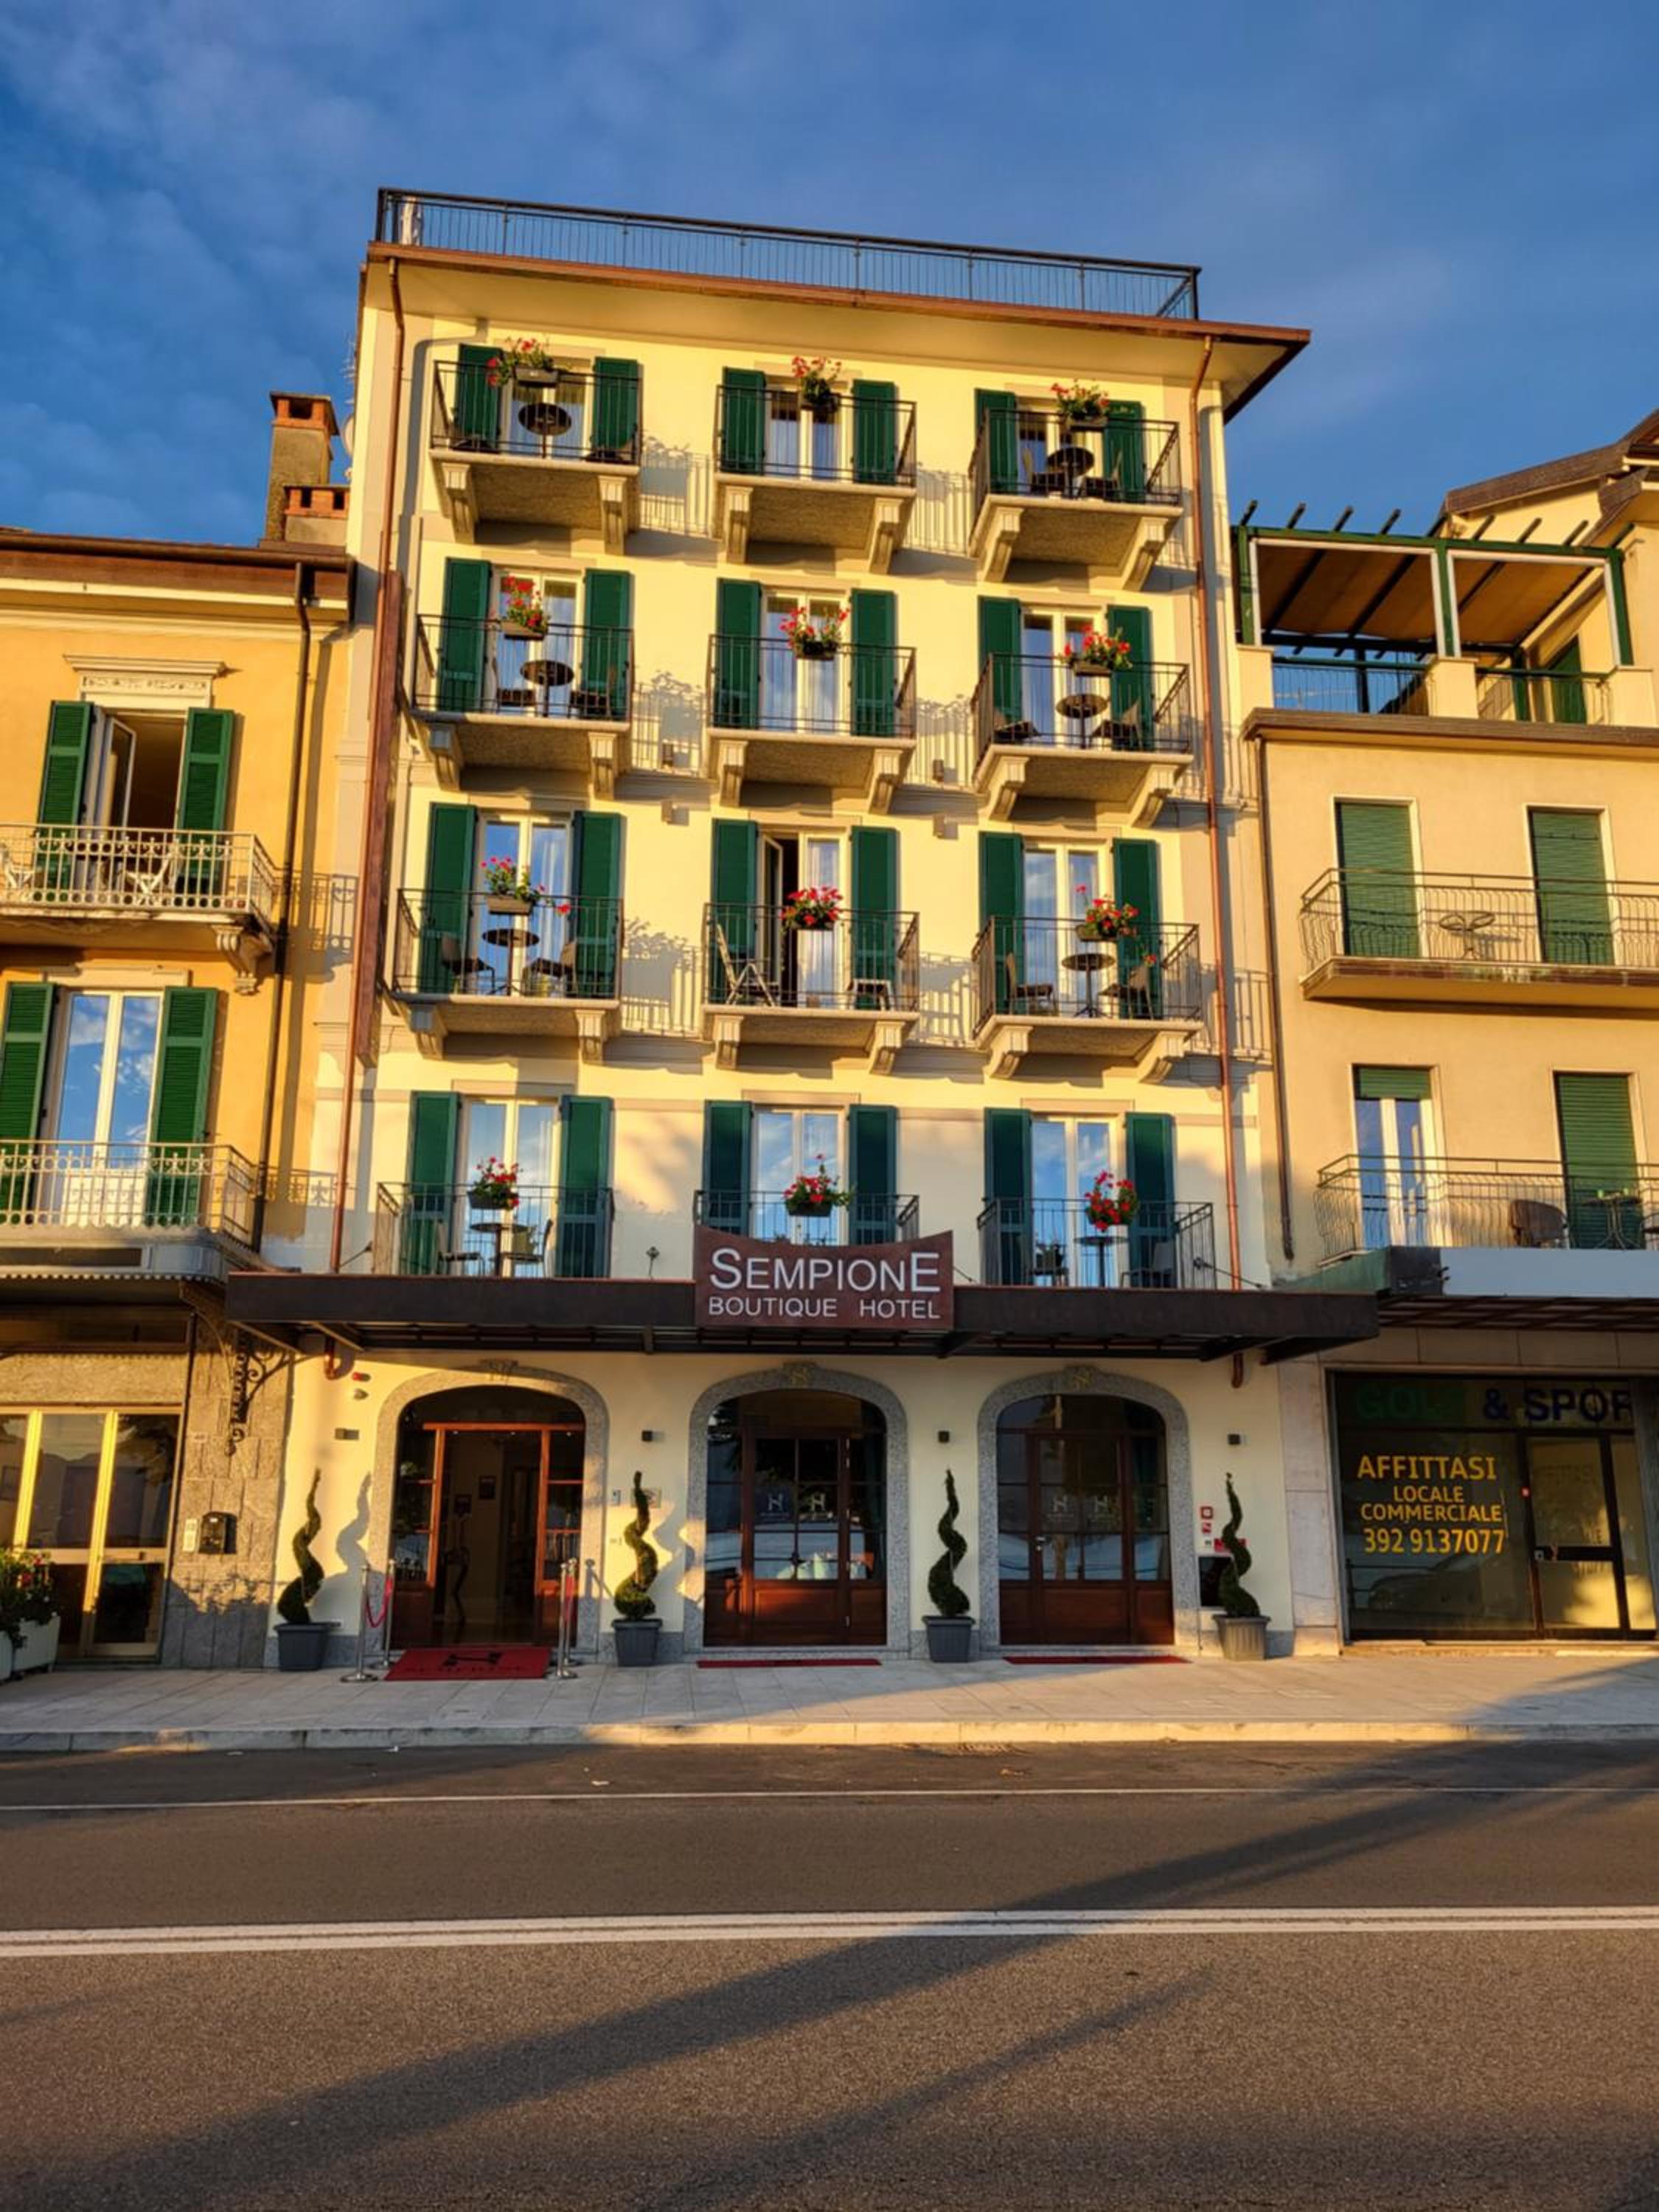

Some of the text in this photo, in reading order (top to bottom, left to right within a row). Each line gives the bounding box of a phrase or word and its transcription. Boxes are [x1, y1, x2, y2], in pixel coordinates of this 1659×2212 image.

[709, 1248, 941, 1293] SEMPIONE
[709, 1296, 941, 1319] BOUTIQUE HOTEL
[1484, 1388, 1509, 1420] &
[1357, 1455, 1497, 1481] AFFITTASI
[1394, 1486, 1464, 1503] LOCALE
[1360, 1503, 1503, 1523] COMMERCIALE
[1363, 1528, 1505, 1555] 392 9137077
